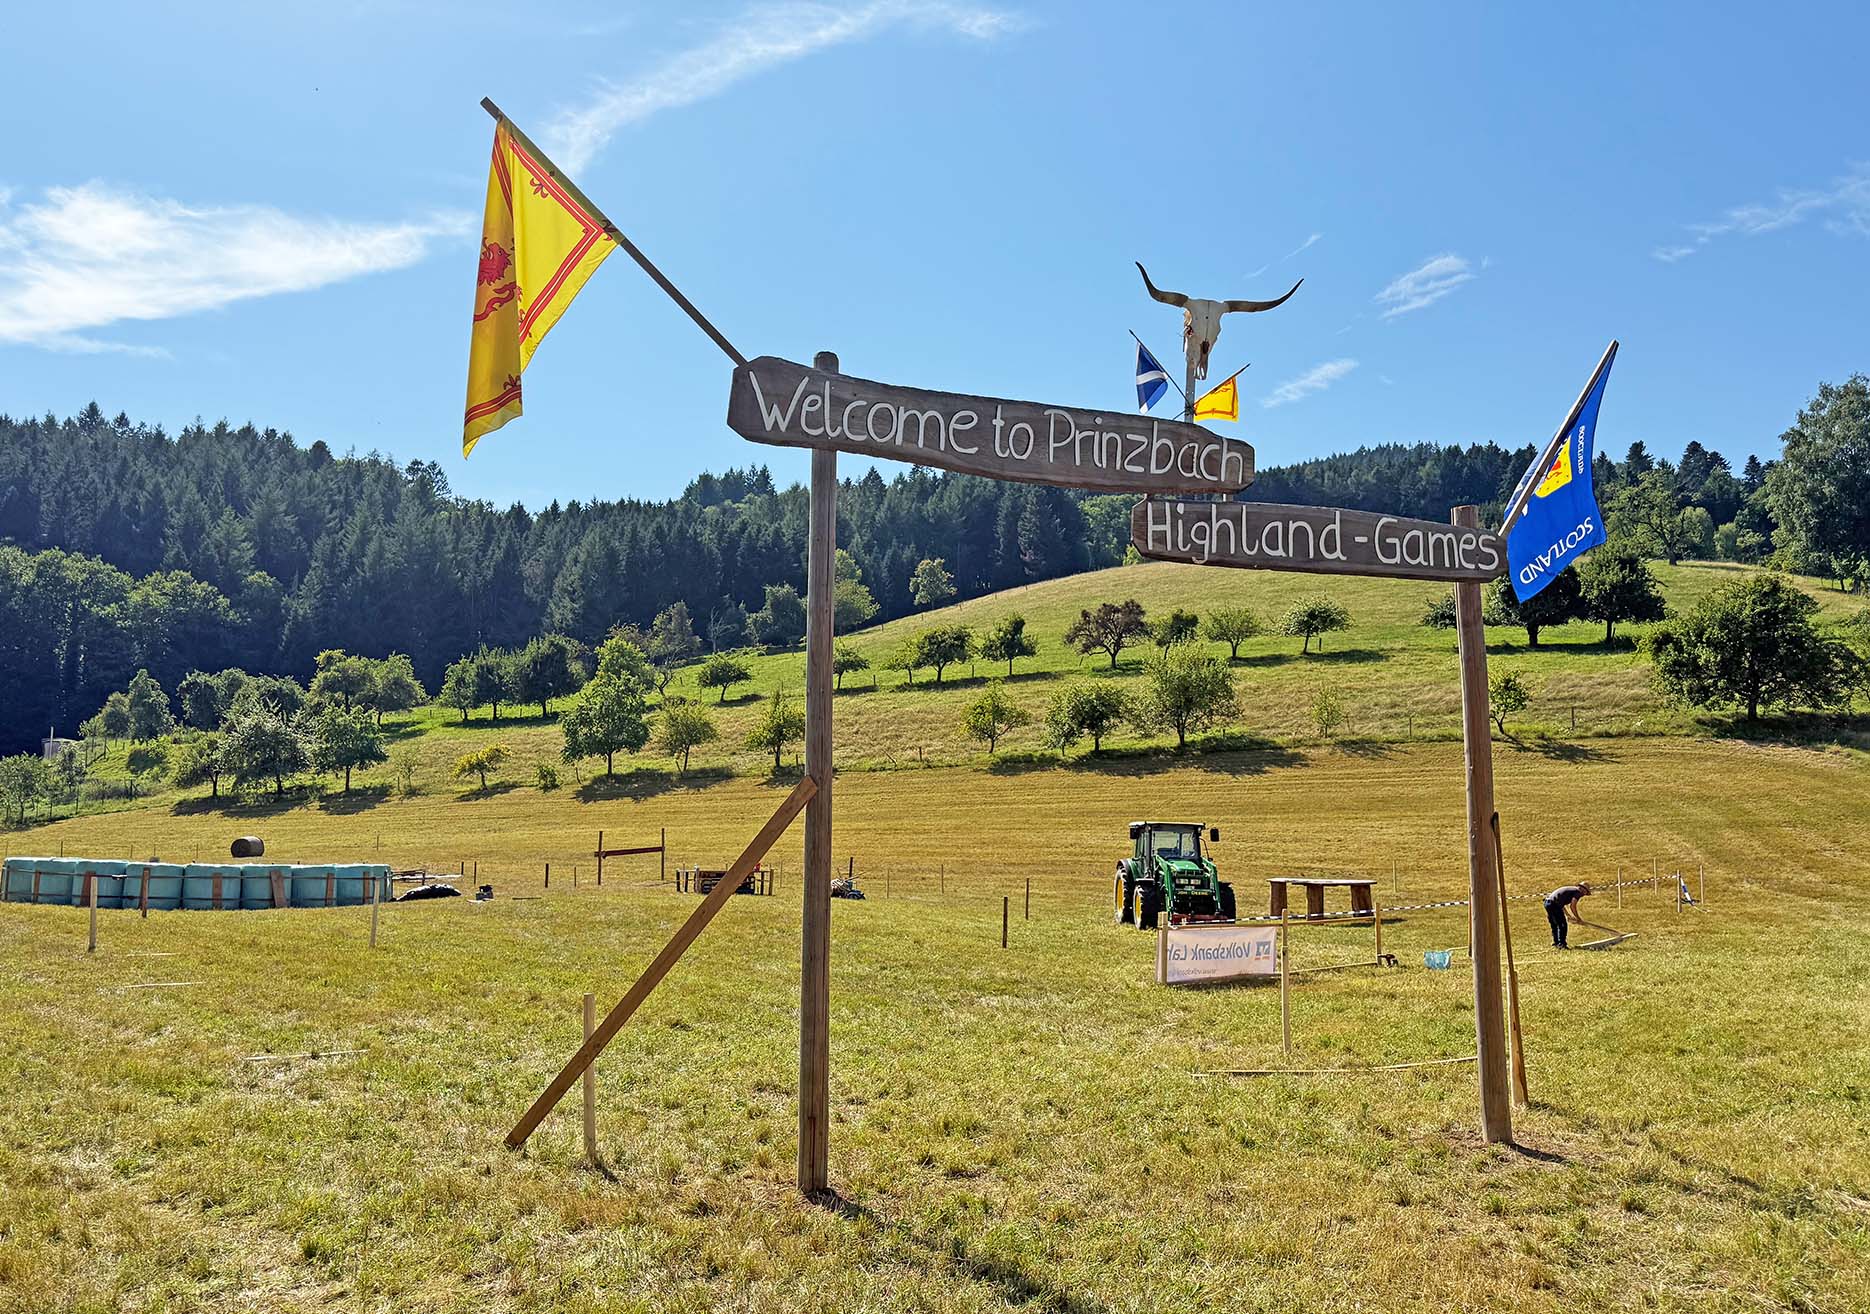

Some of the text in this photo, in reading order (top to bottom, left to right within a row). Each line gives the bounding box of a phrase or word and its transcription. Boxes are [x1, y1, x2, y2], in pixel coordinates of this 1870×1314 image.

[748, 370, 1244, 485] Welcome to Prinzbach
[1519, 516, 1594, 584] SCOTLAND
